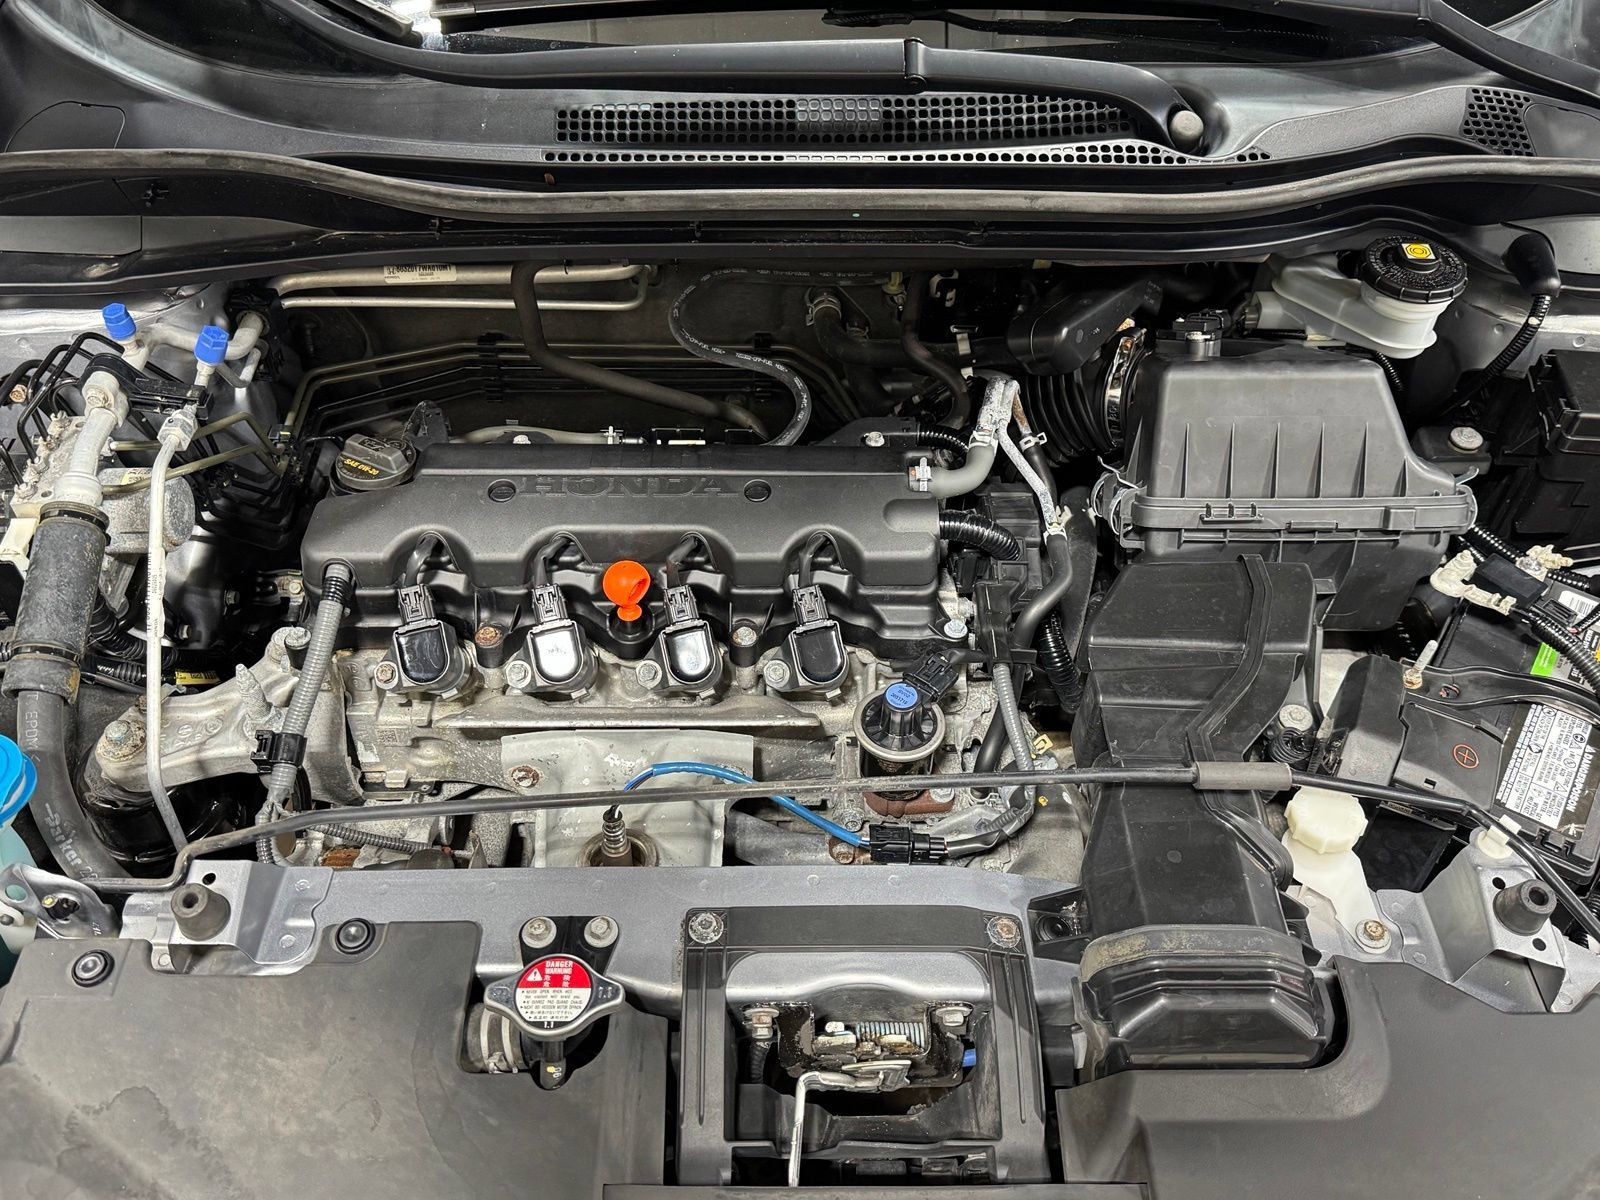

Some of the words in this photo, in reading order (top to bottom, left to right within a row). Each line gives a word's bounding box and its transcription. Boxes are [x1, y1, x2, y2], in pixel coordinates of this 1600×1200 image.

[344, 459, 360, 468] SAE
[360, 464, 380, 475] 0W-20
[518, 476, 740, 498] HONDA
[1566, 753, 1594, 812] DANGER/POISON
